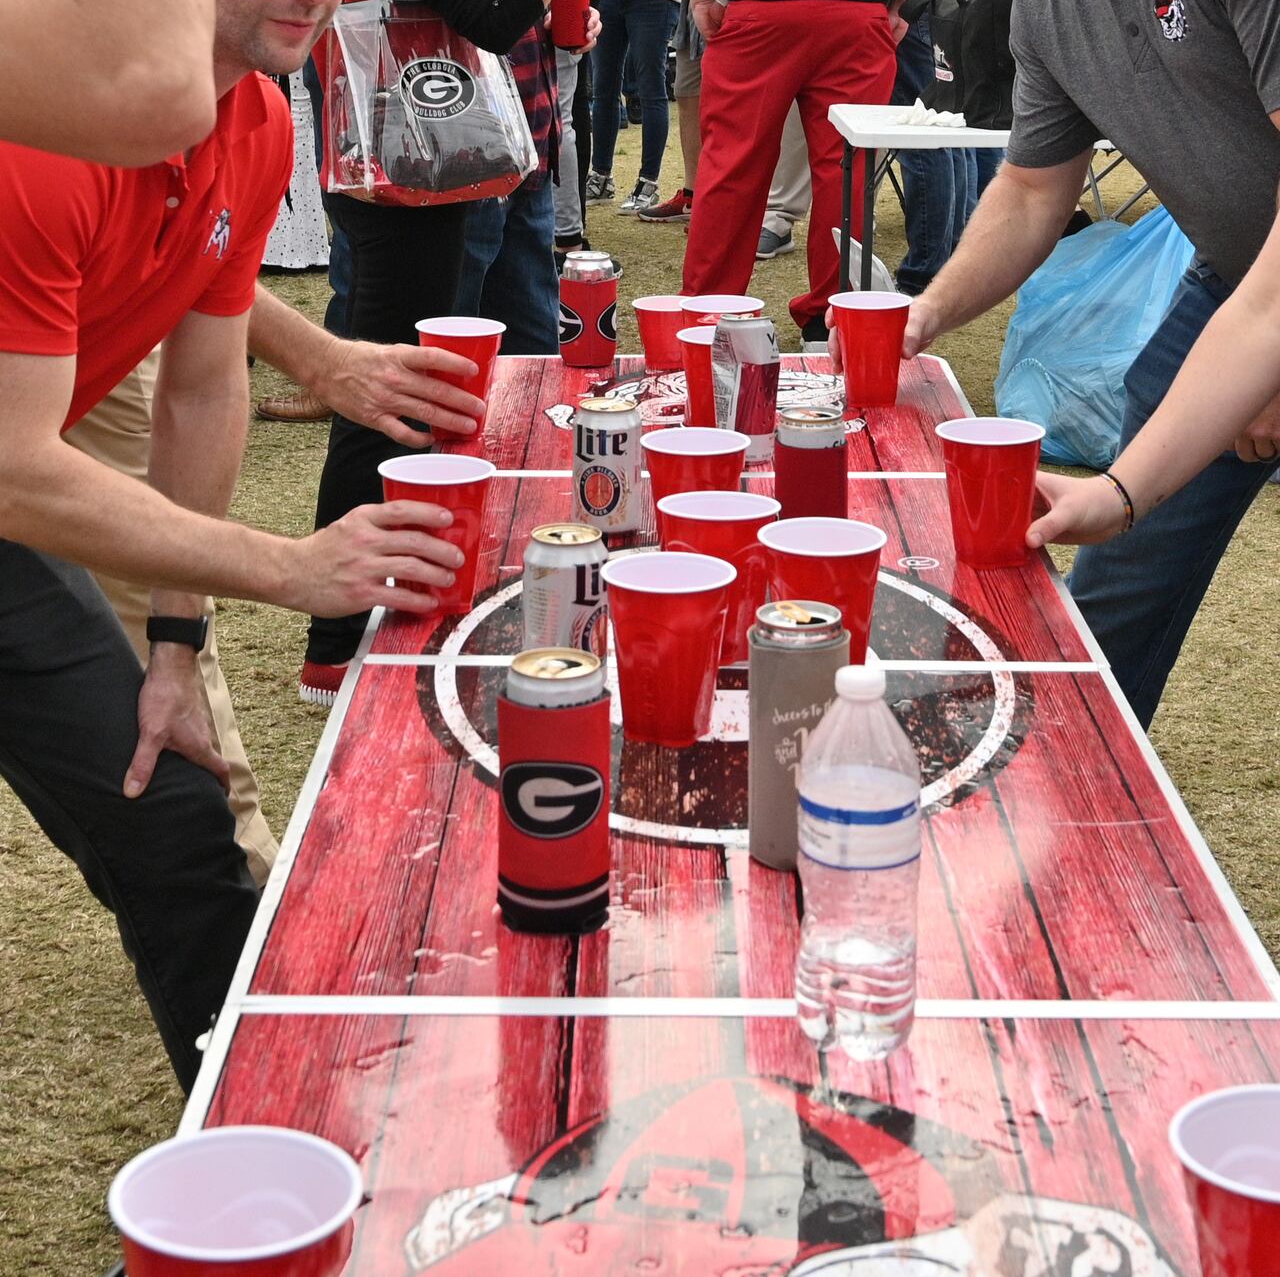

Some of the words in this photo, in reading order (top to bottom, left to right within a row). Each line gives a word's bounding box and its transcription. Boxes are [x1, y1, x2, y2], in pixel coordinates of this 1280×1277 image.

[422, 62, 456, 75] GEORGIA
[449, 100, 466, 114] CLUB
[576, 423, 628, 463] Lite
